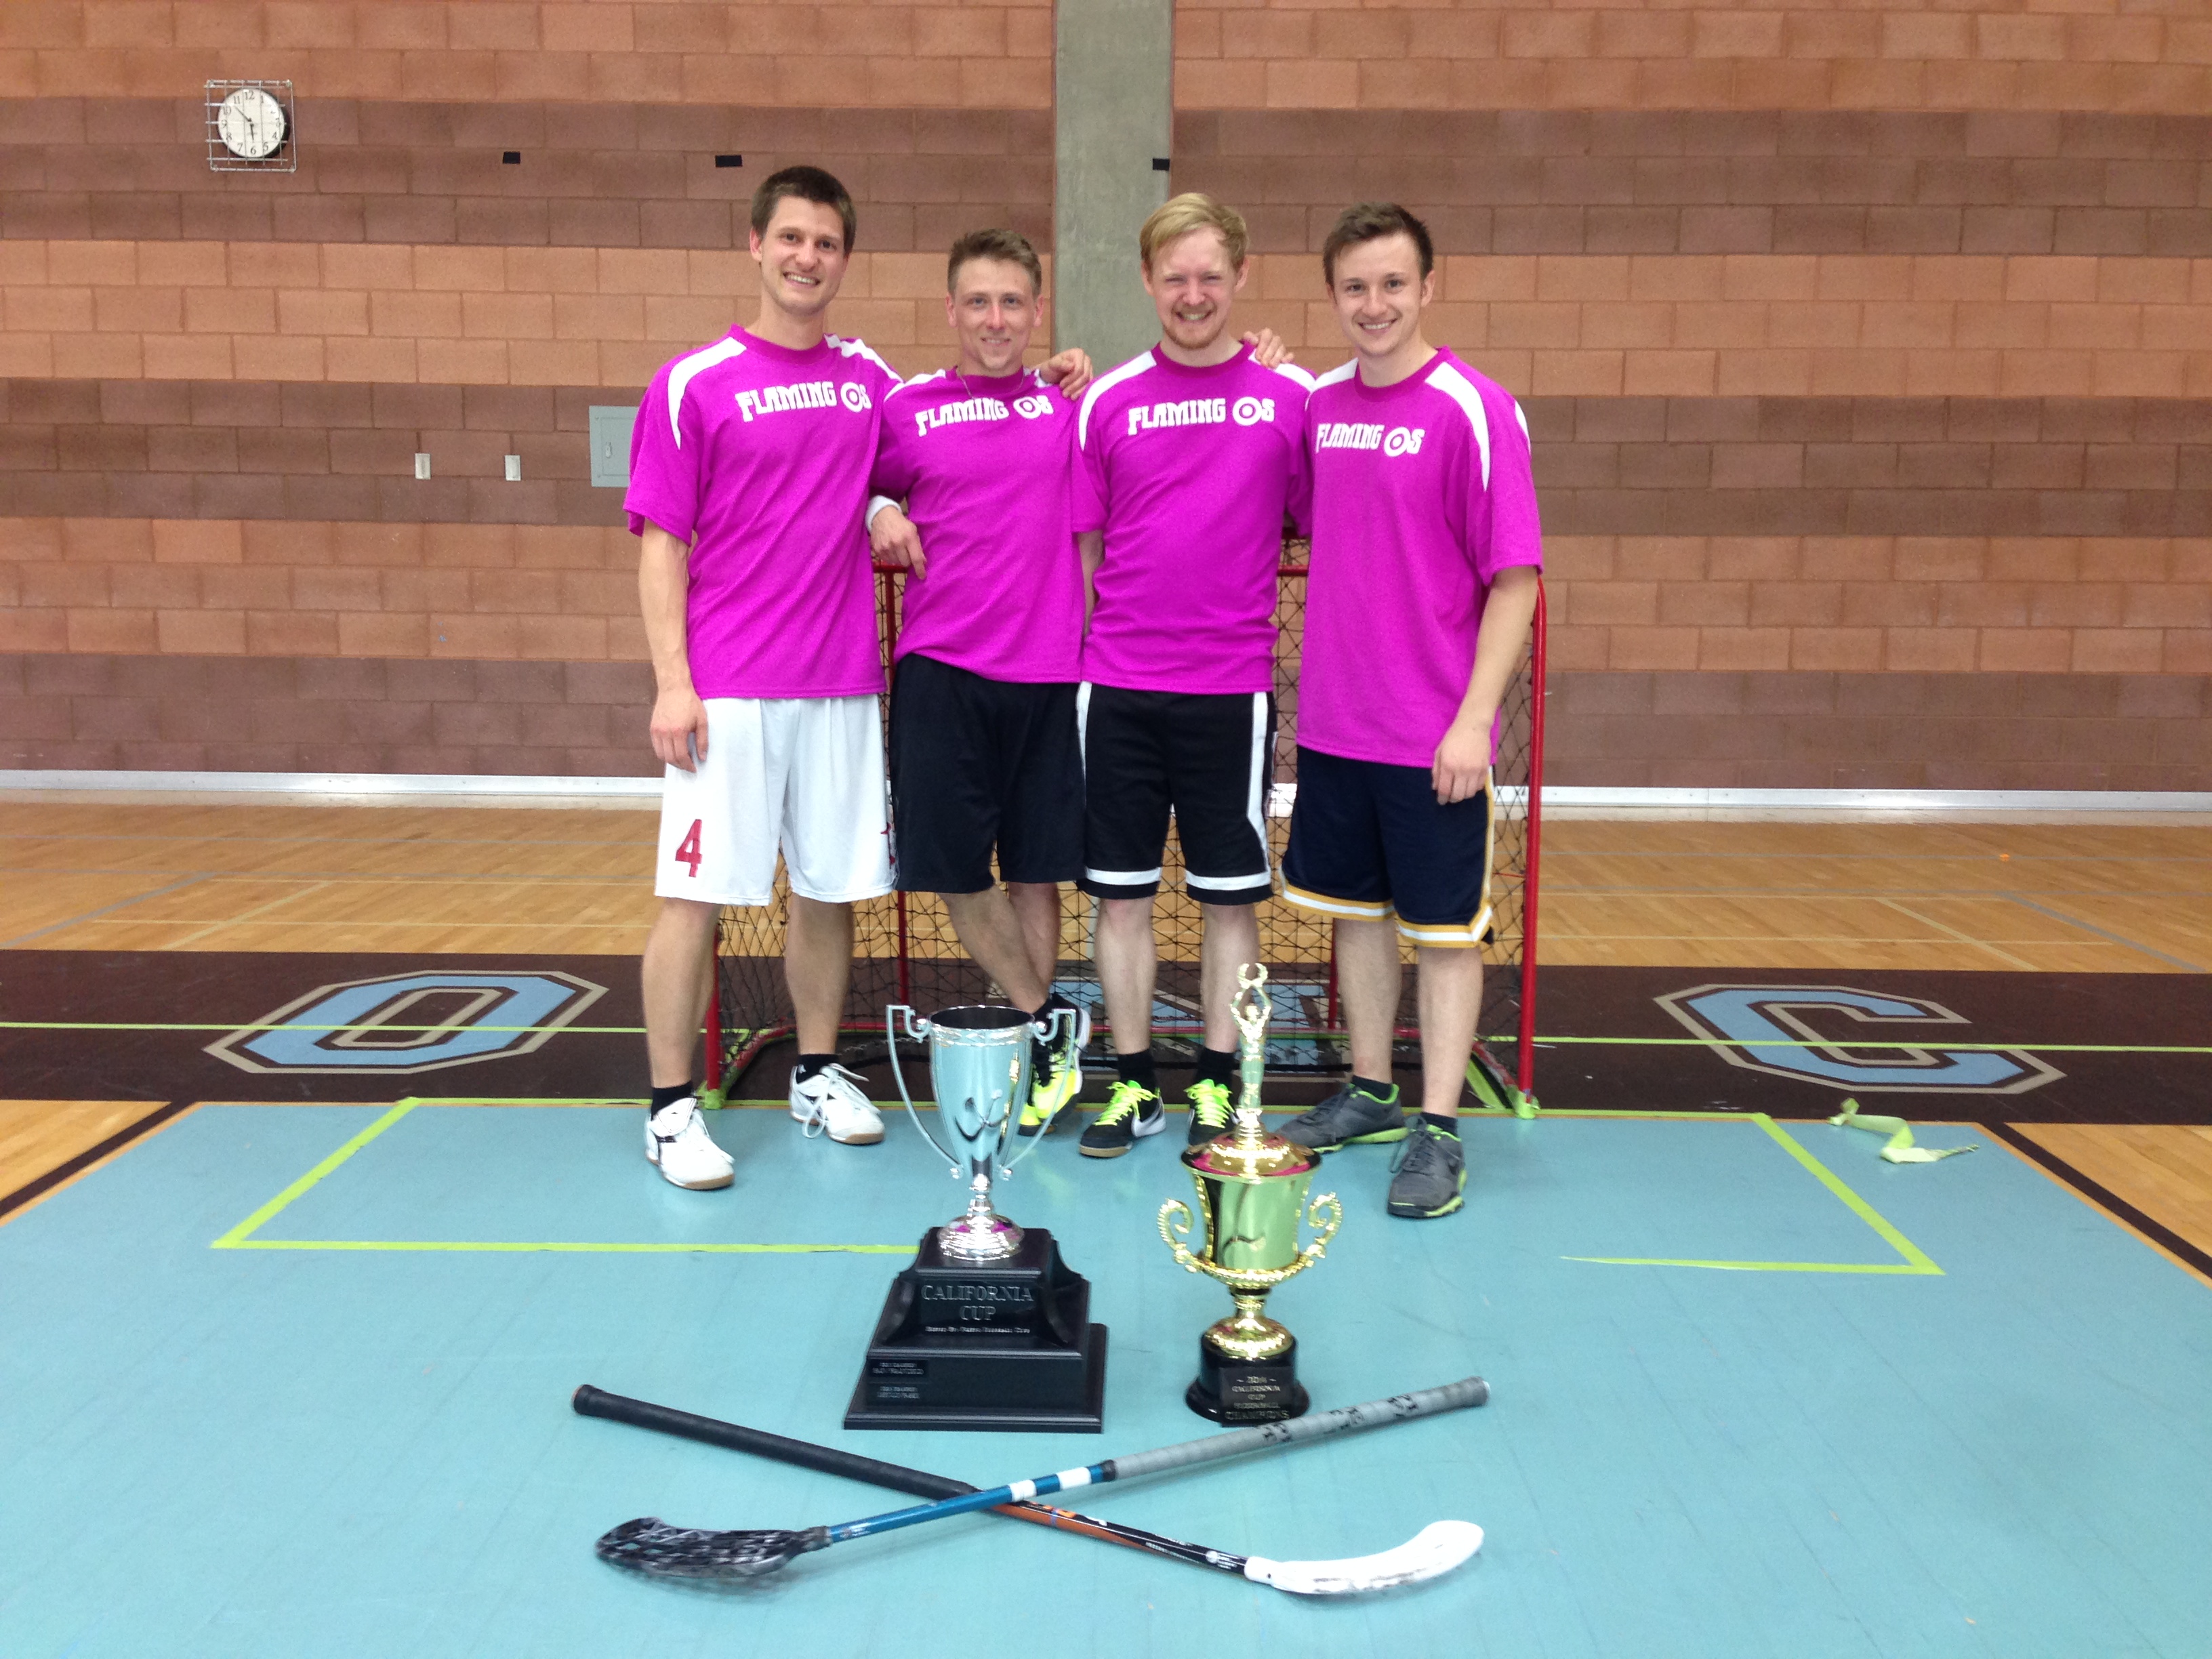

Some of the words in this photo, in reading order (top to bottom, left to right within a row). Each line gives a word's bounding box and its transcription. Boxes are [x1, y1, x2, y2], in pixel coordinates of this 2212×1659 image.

[233, 96, 241, 104] 11
[245, 91, 255, 100] 12
[237, 142, 243, 152] 7
[250, 146, 256, 155] 6
[735, 382, 837, 422] FLAMING
[915, 398, 1009, 436] FLAMING
[1128, 398, 1226, 435] FLAMING
[1316, 424, 1384, 453] FLAMING
[675, 819, 702, 878] 4
[1652, 984, 2067, 1094] C
[920, 1285, 1034, 1302] CALIFORNIA
[959, 1305, 996, 1321] CUP
